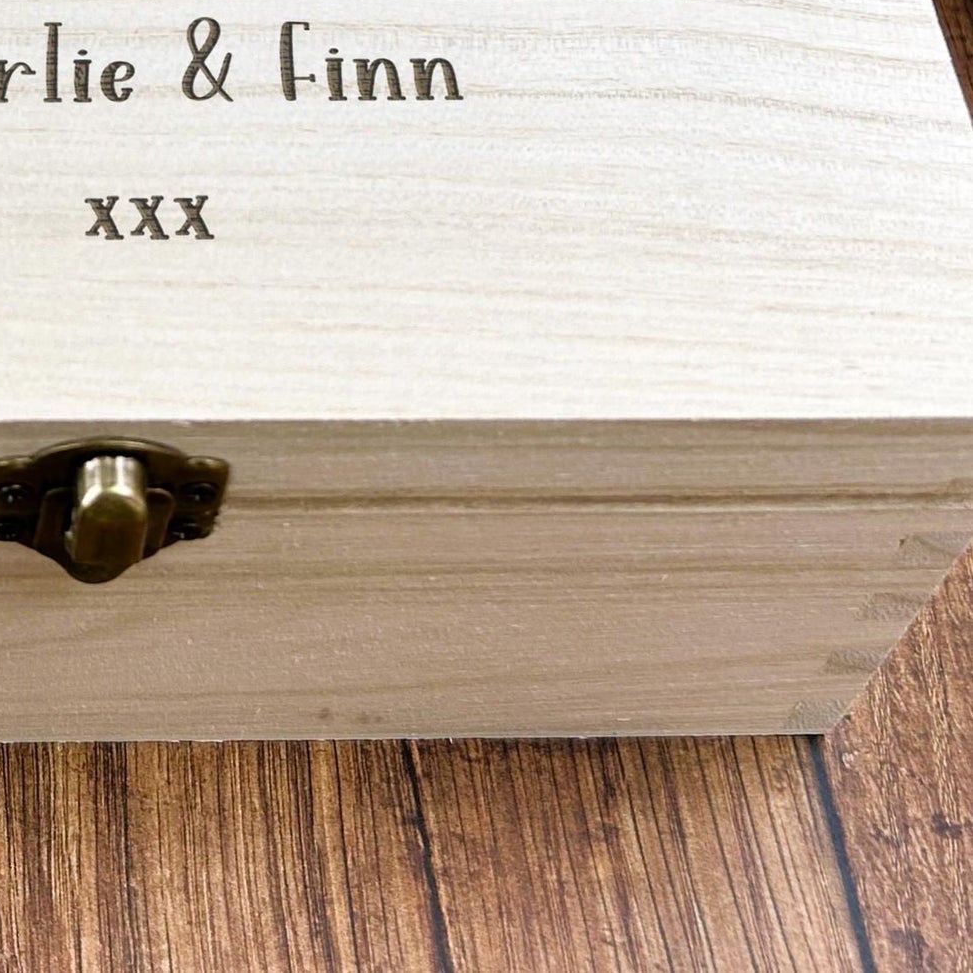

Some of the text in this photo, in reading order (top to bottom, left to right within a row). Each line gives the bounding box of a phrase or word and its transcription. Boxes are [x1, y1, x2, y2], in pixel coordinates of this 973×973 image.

[181, 16, 234, 102] &
[279, 21, 464, 102] Finn
[84, 195, 215, 241] xxx
